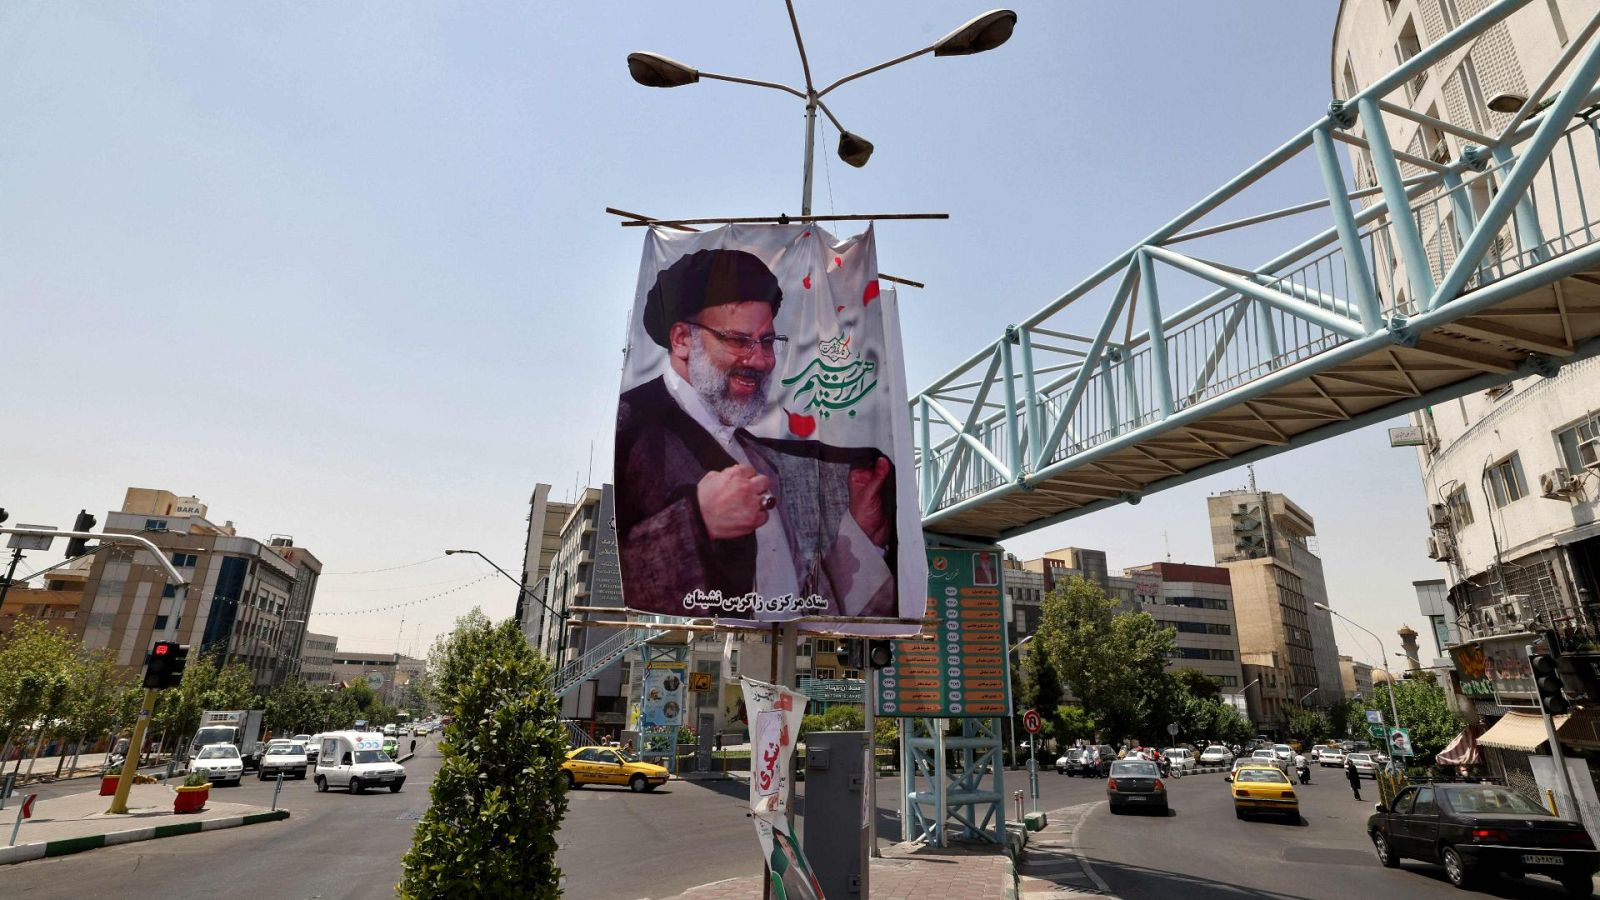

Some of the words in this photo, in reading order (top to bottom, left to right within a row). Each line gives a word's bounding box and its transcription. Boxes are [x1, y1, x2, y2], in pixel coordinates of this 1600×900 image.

[683, 588, 722, 609] نشینان
[721, 591, 764, 612] زاگرس
[765, 592, 804, 612] مرکزی
[806, 594, 828, 609] ستاد
